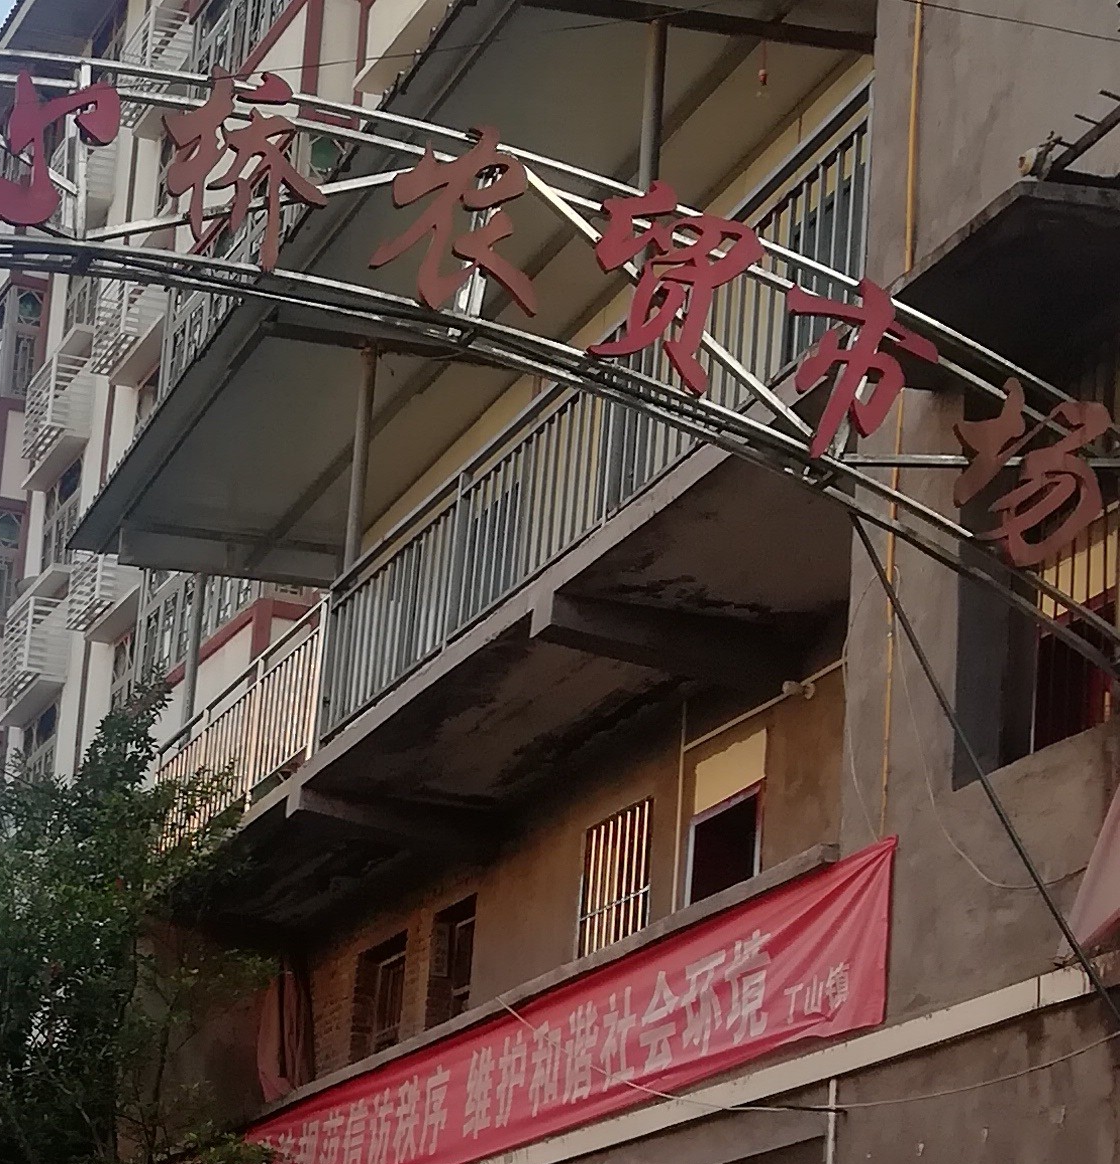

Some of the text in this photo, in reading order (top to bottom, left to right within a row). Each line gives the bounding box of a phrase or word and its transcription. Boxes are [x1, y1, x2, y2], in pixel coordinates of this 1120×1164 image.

[464, 929, 773, 1139] 维护和谐社会环境
[784, 962, 850, 1025] 丁山镇
